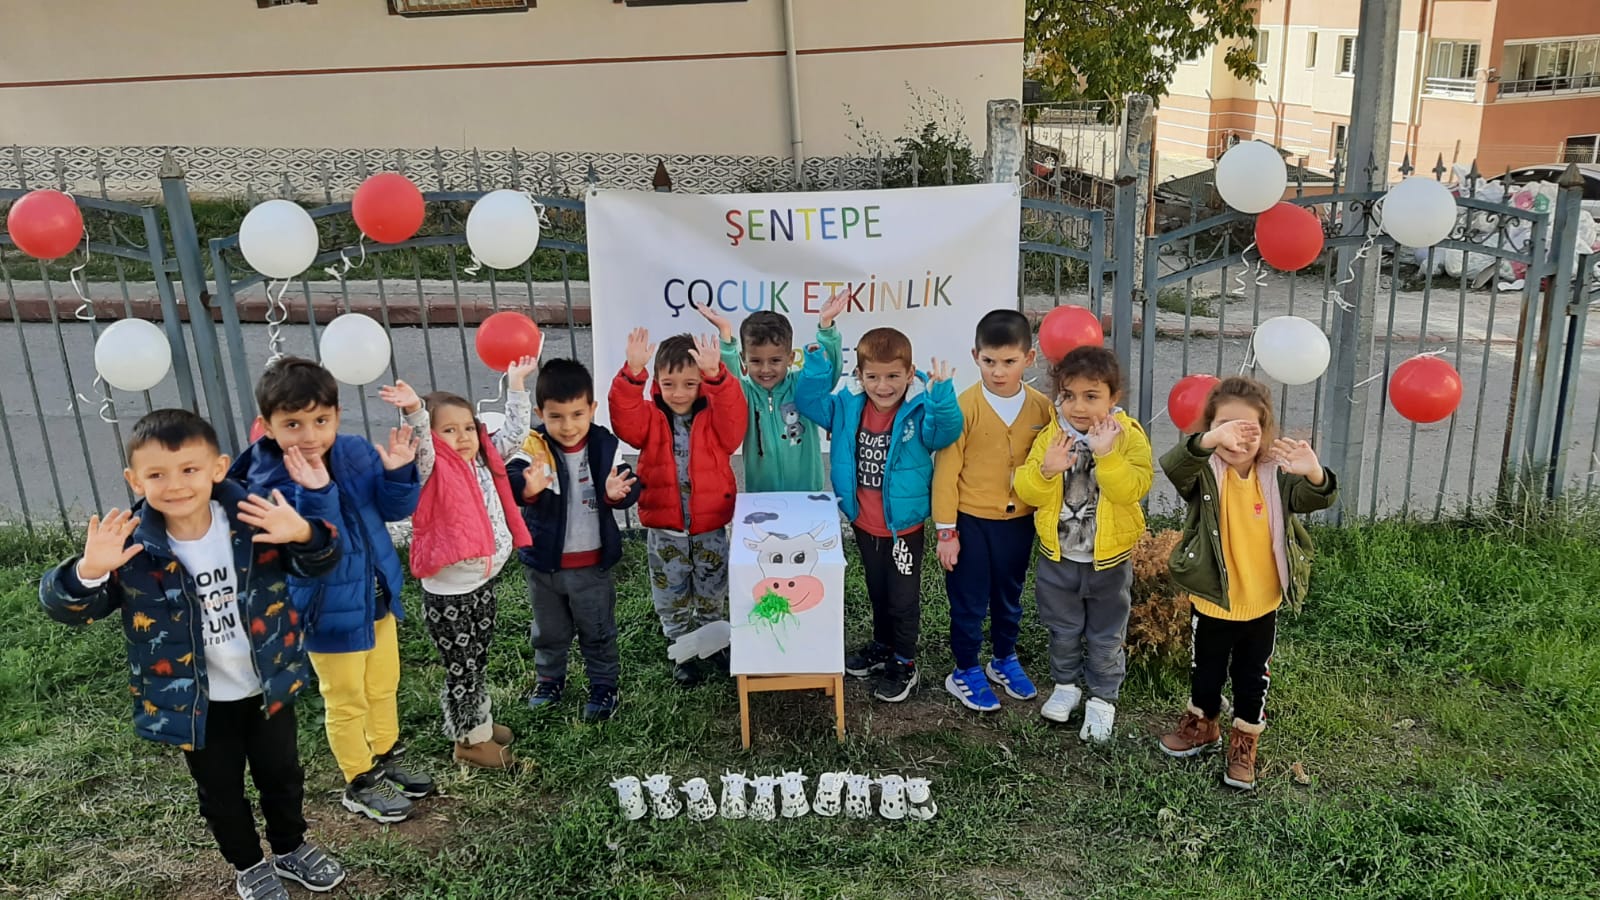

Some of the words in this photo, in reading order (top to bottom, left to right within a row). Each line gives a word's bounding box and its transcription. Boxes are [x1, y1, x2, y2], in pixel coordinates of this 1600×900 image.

[725, 205, 882, 246] ŞENTEPE
[663, 278, 790, 318] ÇOCUK
[803, 270, 953, 314] ETKİNLİK
[859, 431, 892, 448] SUPER
[859, 446, 888, 461] COOL
[858, 460, 886, 475] KIDS
